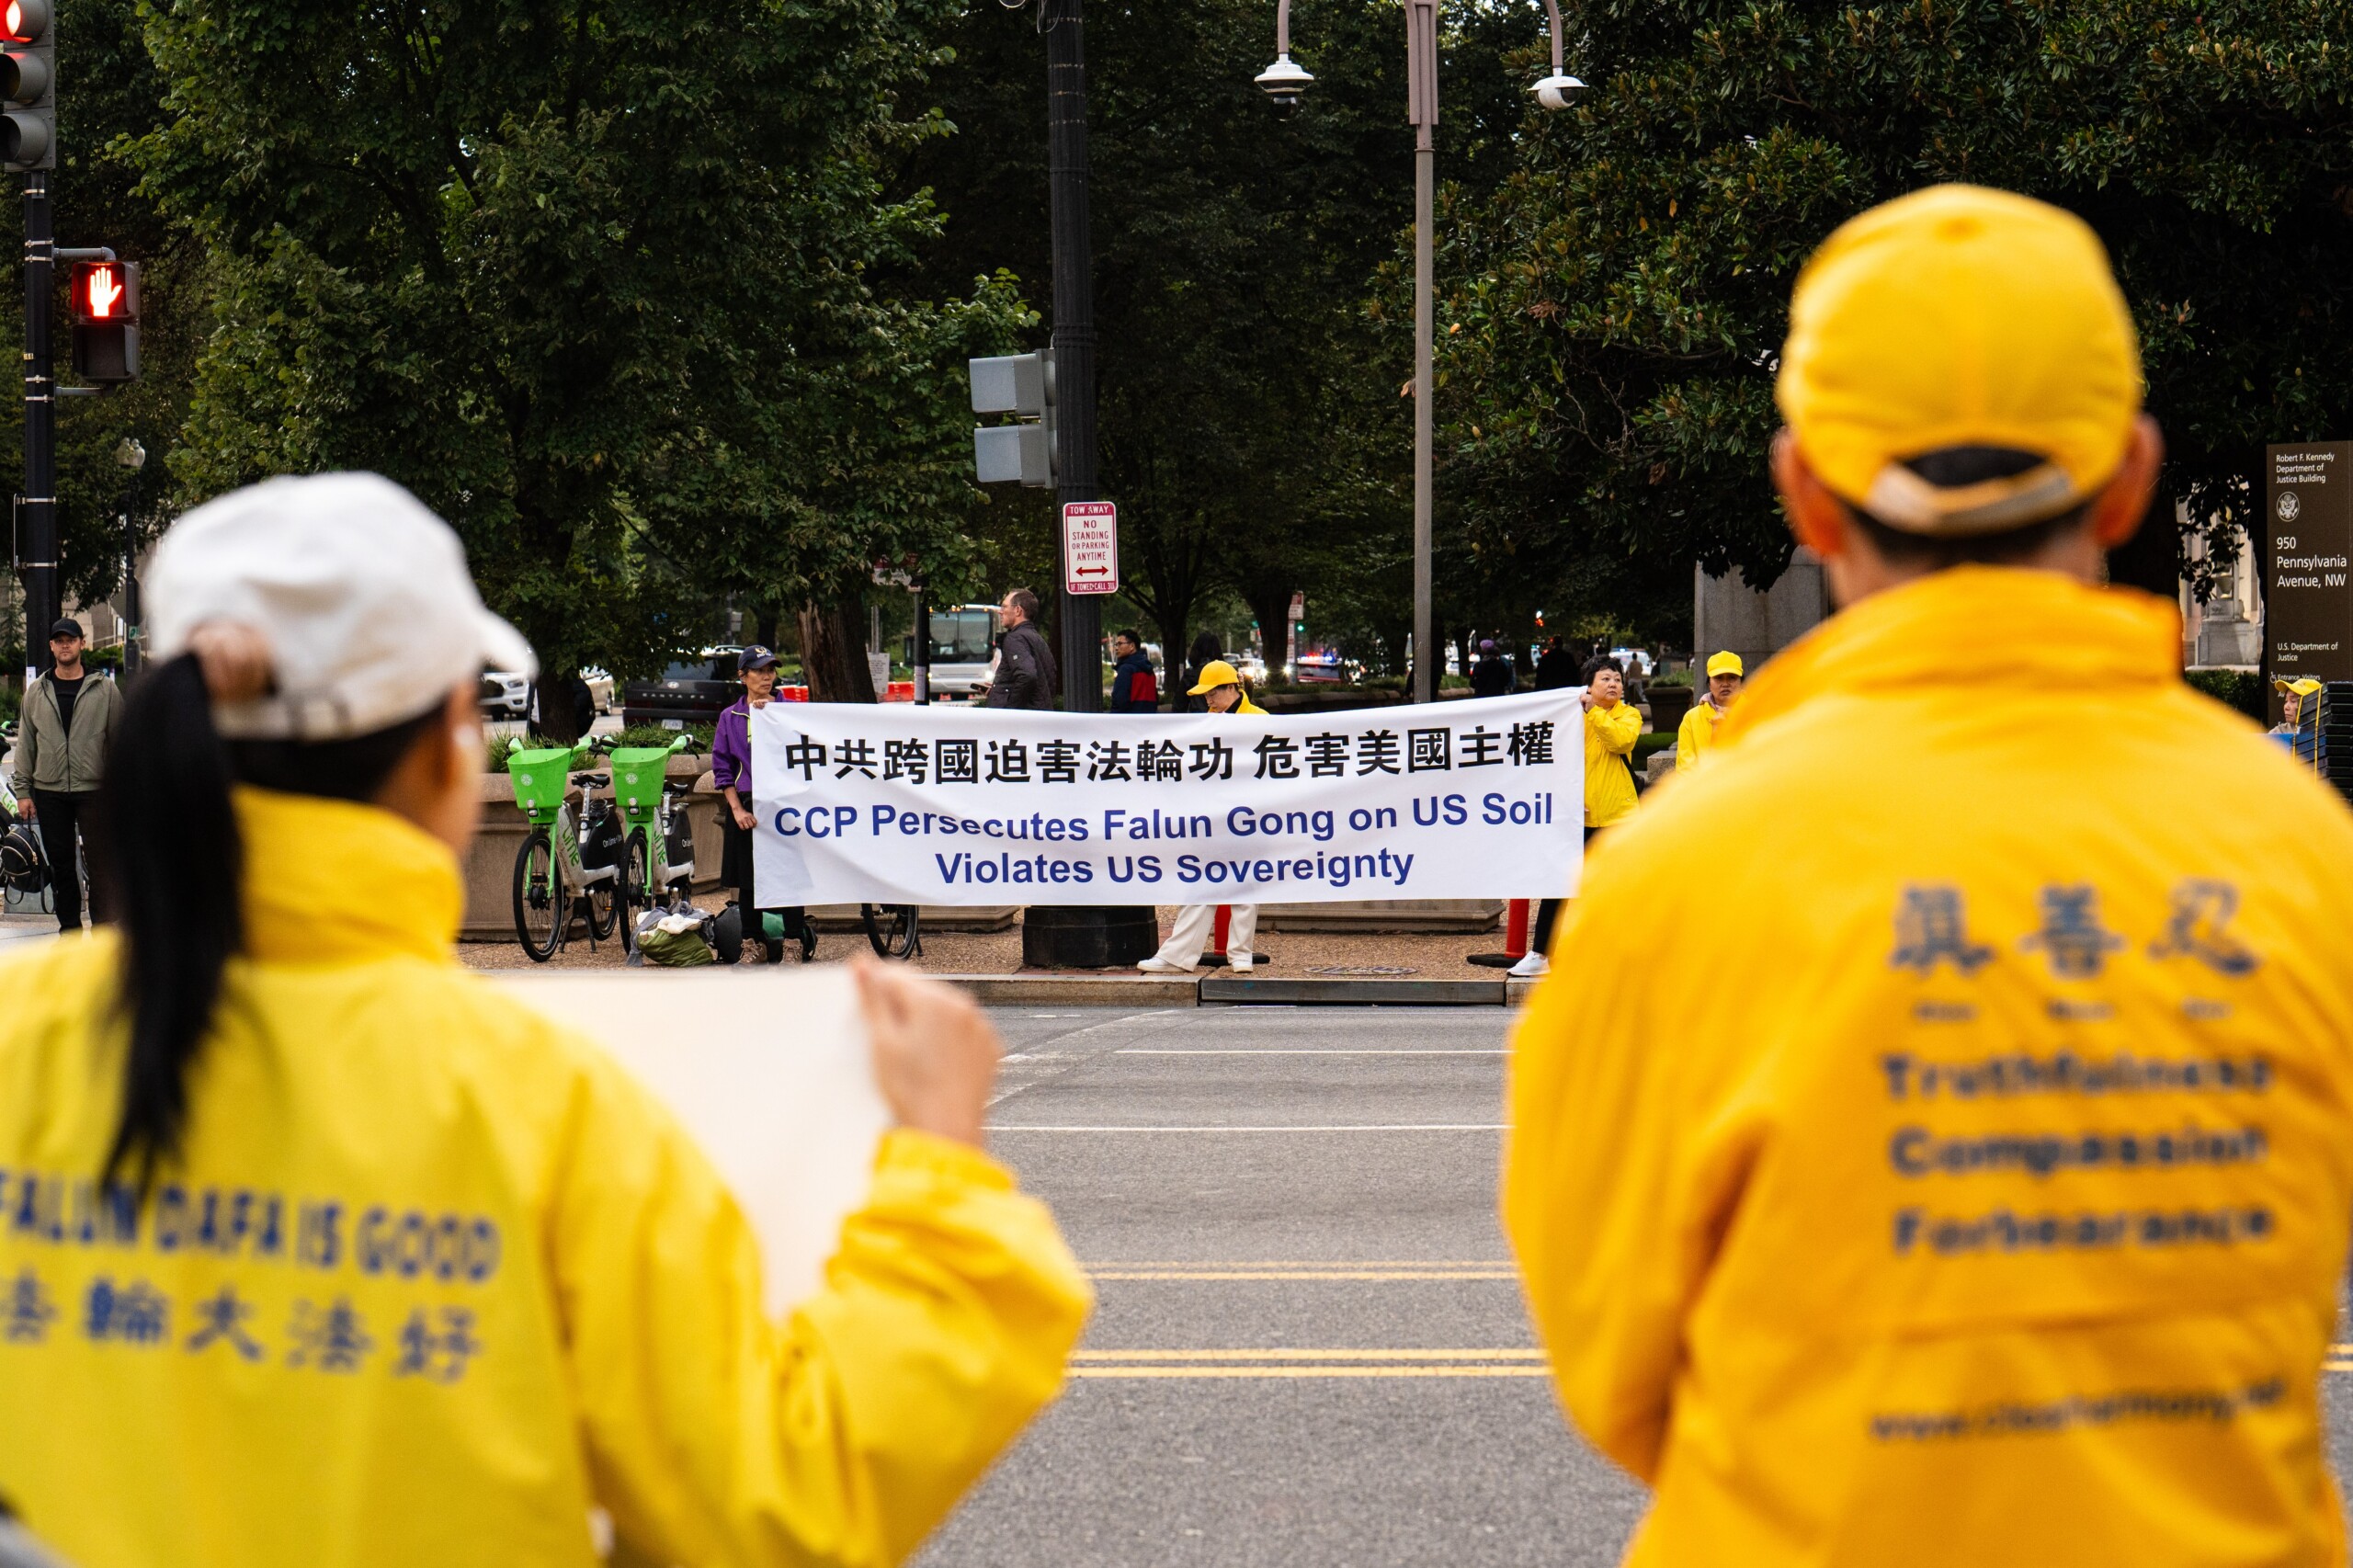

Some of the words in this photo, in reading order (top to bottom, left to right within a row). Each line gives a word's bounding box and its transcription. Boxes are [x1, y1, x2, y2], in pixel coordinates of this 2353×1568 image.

[2276, 454, 2298, 462] Robert
[2305, 452, 2335, 462] Kennedy
[2276, 465, 2315, 474] Department
[2316, 462, 2325, 472] of
[2276, 475, 2298, 483] Justice
[2299, 473, 2326, 484] Building
[1070, 506, 1086, 515] TOW
[1087, 506, 1109, 514] AWAY
[1083, 520, 1097, 528] NO
[1072, 531, 1109, 540] STANDING
[1081, 541, 1109, 550] PARKING
[2276, 536, 2297, 550] 950
[1076, 551, 1107, 562] ANYTIME
[2276, 554, 2347, 572] Pennsylvania
[2277, 574, 2322, 588] Avenue,
[2325, 574, 2347, 587] NW
[2277, 642, 2290, 651] U.S.
[2290, 642, 2330, 652] Department
[2330, 642, 2338, 651] of
[2277, 653, 2299, 662] Justice
[786, 734, 1233, 784] 中共跨國迫害法輪功
[1253, 721, 1555, 779] 危害美國主權
[775, 806, 858, 838] CCP
[872, 804, 1089, 842] Persecutes
[1104, 808, 1213, 841] Falun
[1227, 806, 1335, 842] Gong
[1348, 807, 1397, 832] on
[1412, 793, 1468, 826] US
[1482, 792, 1552, 824] Soil
[936, 852, 1094, 883] Violates
[1108, 855, 1163, 883] US
[1176, 847, 1415, 888] Sovereignty
[297, 1199, 344, 1270] IS
[356, 1202, 503, 1282] GOOD
